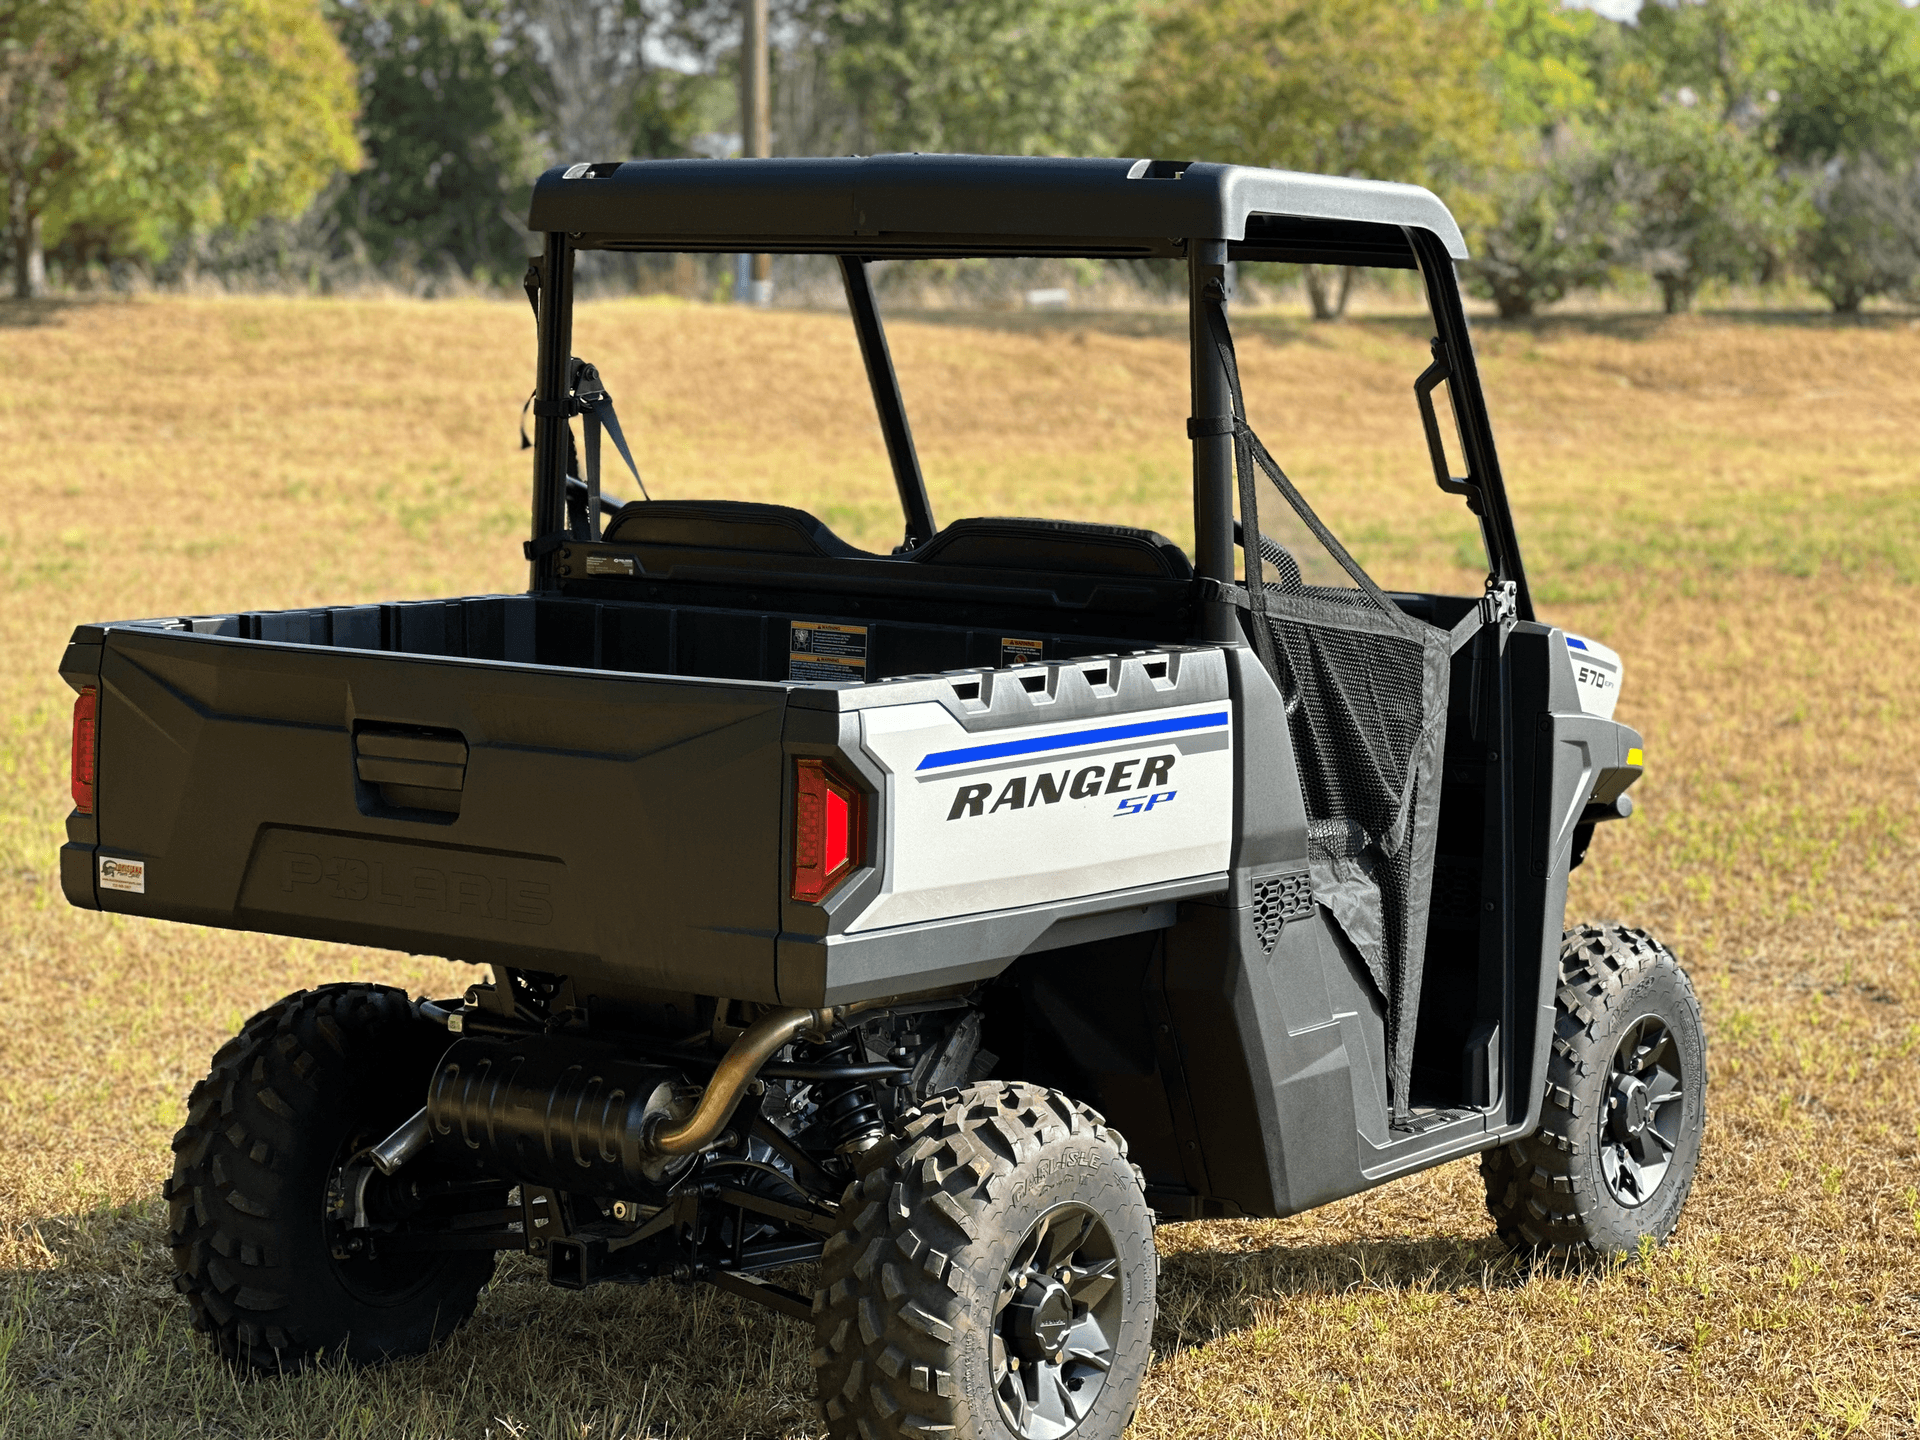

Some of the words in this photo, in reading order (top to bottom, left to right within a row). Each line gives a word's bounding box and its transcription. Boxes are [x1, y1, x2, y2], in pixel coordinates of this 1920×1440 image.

[1578, 667, 1605, 689] 570
[946, 754, 1176, 821] RANGER
[1113, 790, 1178, 817] SP
[280, 850, 554, 926] POLARIS
[1012, 1151, 1101, 1208] CARLISLE
